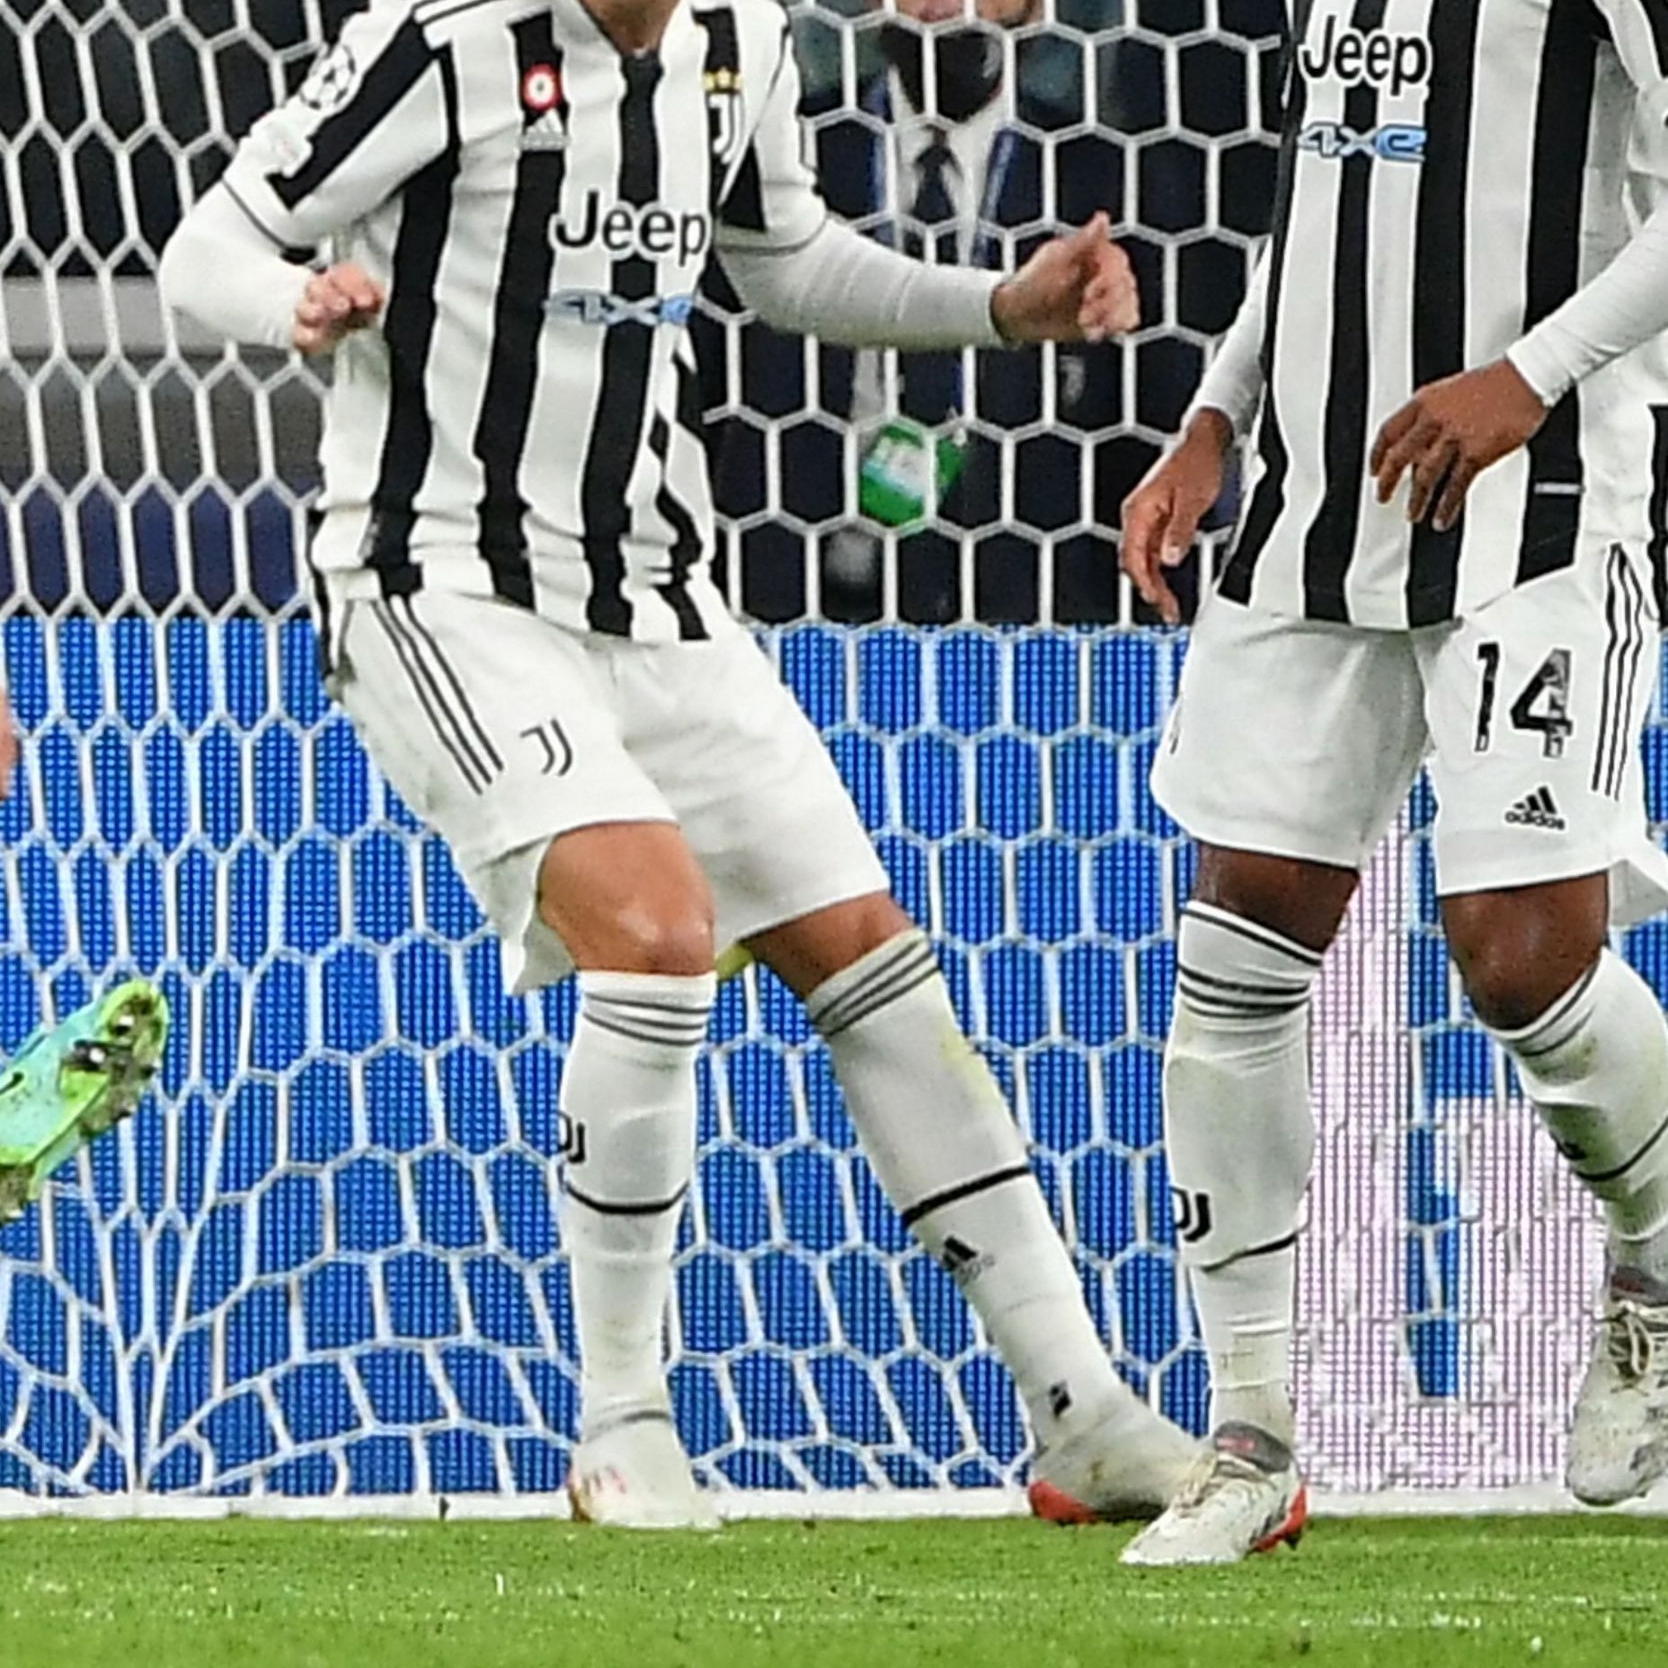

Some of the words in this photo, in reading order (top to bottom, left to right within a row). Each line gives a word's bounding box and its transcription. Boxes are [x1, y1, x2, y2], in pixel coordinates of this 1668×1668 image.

[1301, 14, 1428, 96] Jeep
[555, 189, 707, 268] Jeep
[1473, 642, 1573, 758] 14
[1504, 810, 1565, 832] adidas
